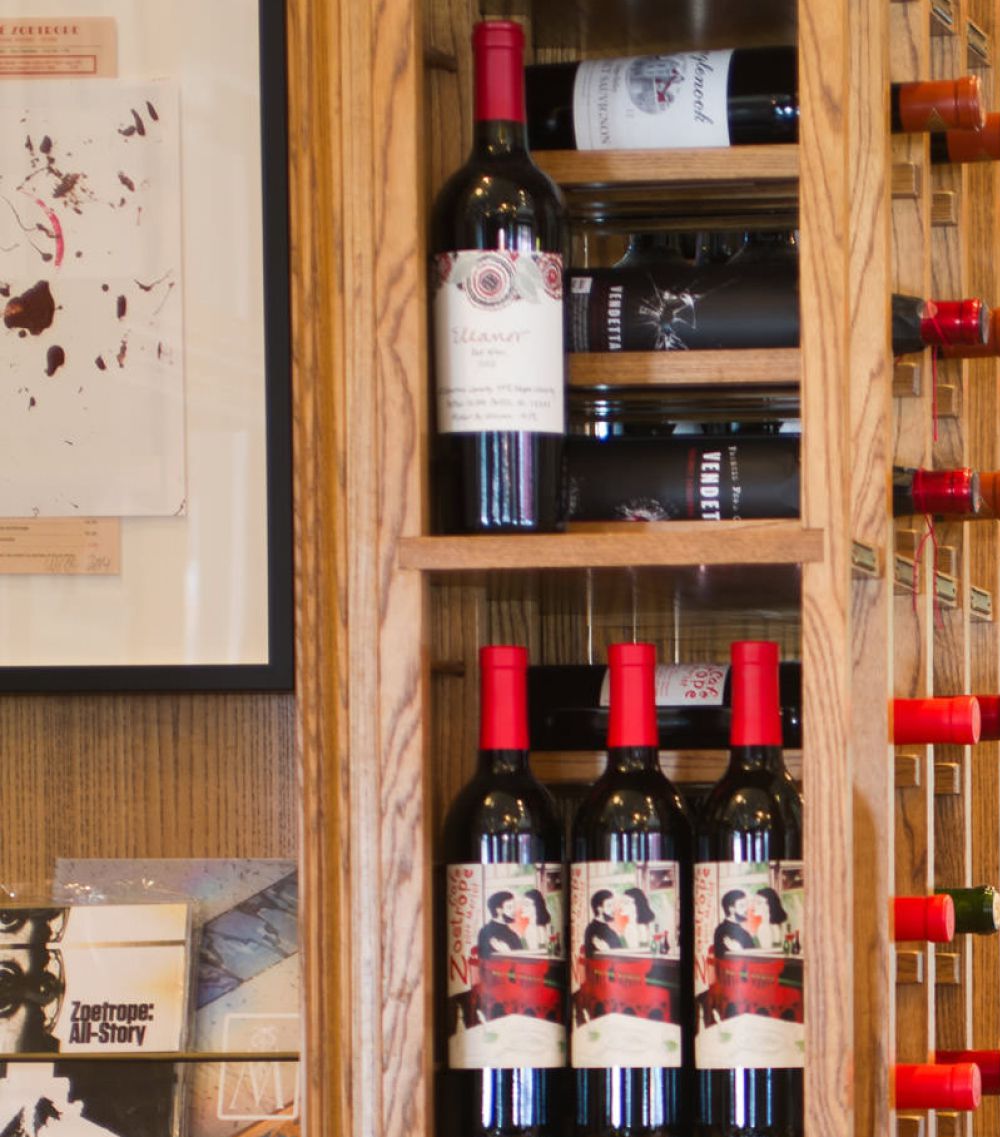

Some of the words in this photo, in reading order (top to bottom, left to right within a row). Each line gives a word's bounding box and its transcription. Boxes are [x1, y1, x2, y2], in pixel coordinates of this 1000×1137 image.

[607, 285, 623, 350] VENDETTA
[71, 1001, 155, 1023] Zoetrope:
[69, 1022, 146, 1047] All-Story
